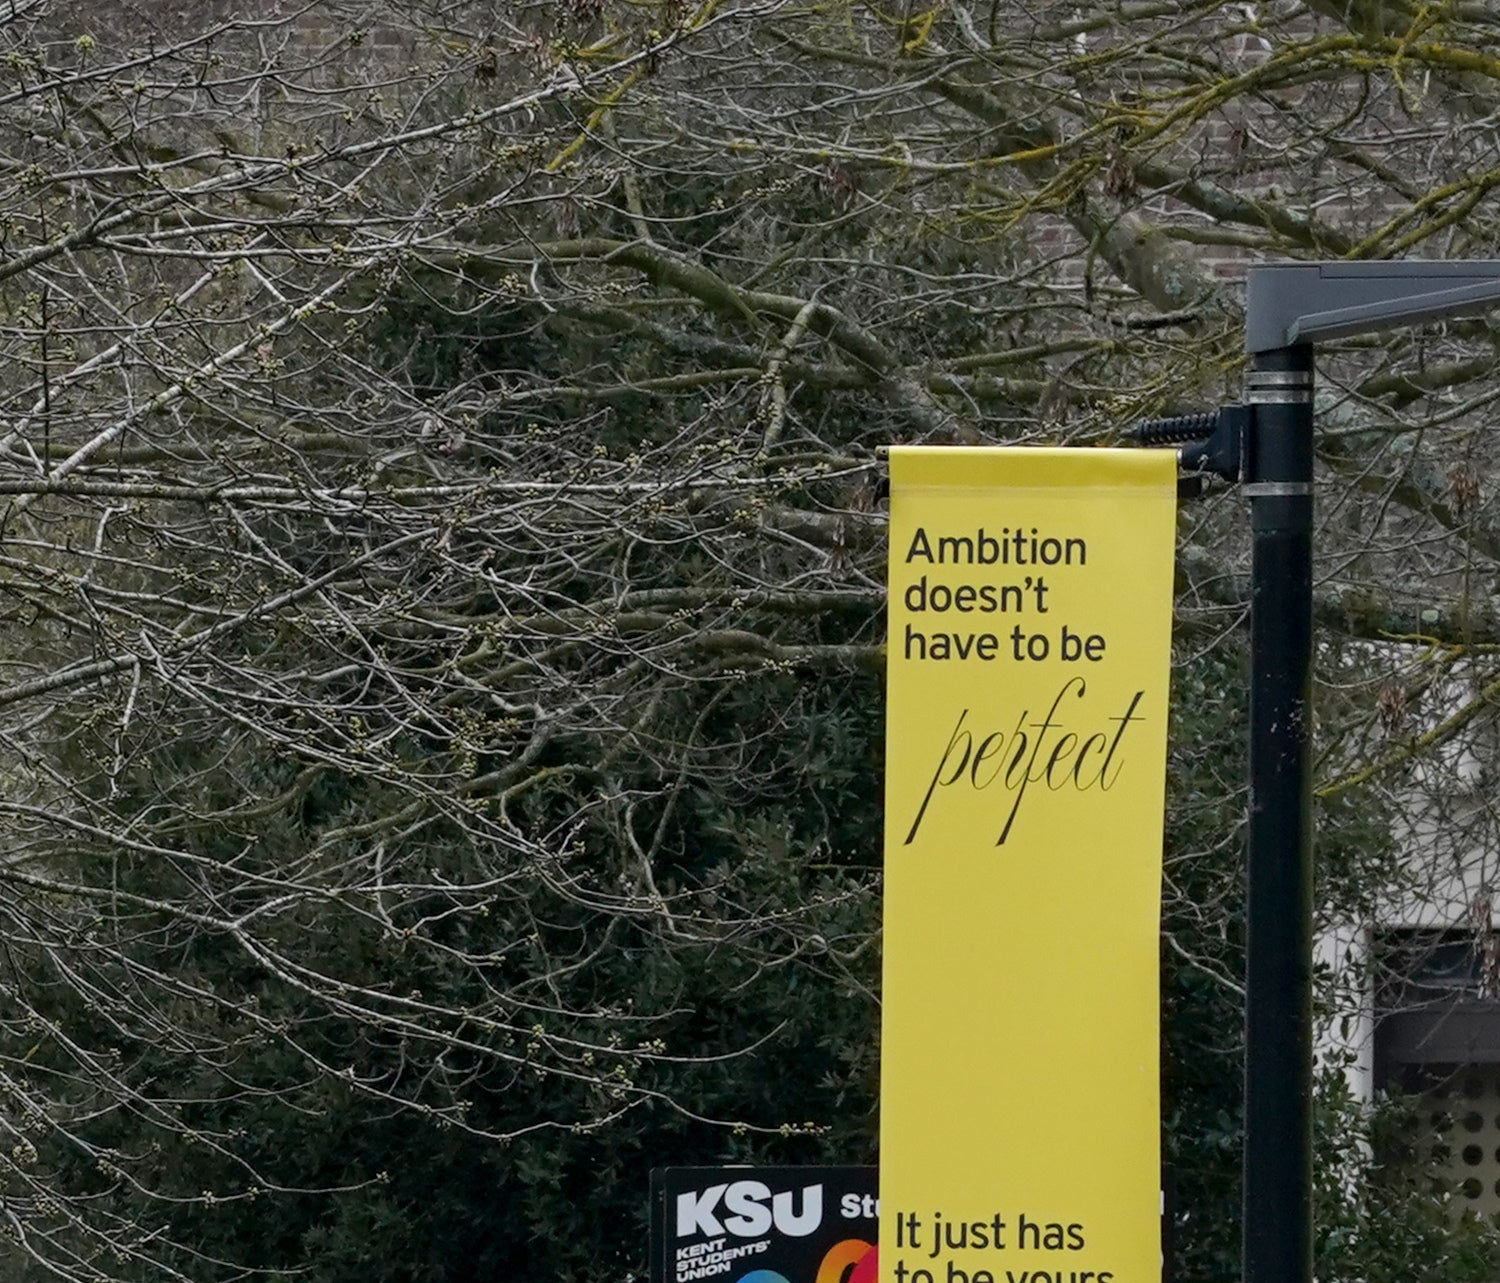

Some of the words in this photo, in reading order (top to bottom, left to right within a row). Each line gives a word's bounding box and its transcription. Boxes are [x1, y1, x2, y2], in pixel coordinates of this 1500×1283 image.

[905, 528, 1087, 566] Ambition
[904, 575, 1049, 613] doesn't
[904, 625, 999, 661] have
[1010, 625, 1050, 661] to
[1061, 626, 1106, 662] be
[903, 676, 1146, 847] perfect
[676, 1180, 823, 1237] KSU
[676, 1238, 727, 1261] KENT
[896, 1212, 921, 1248] It
[929, 1212, 1006, 1258] just
[1018, 1213, 1085, 1251] has
[676, 1240, 772, 1272] STUDENTS'
[676, 1261, 732, 1283] UNION
